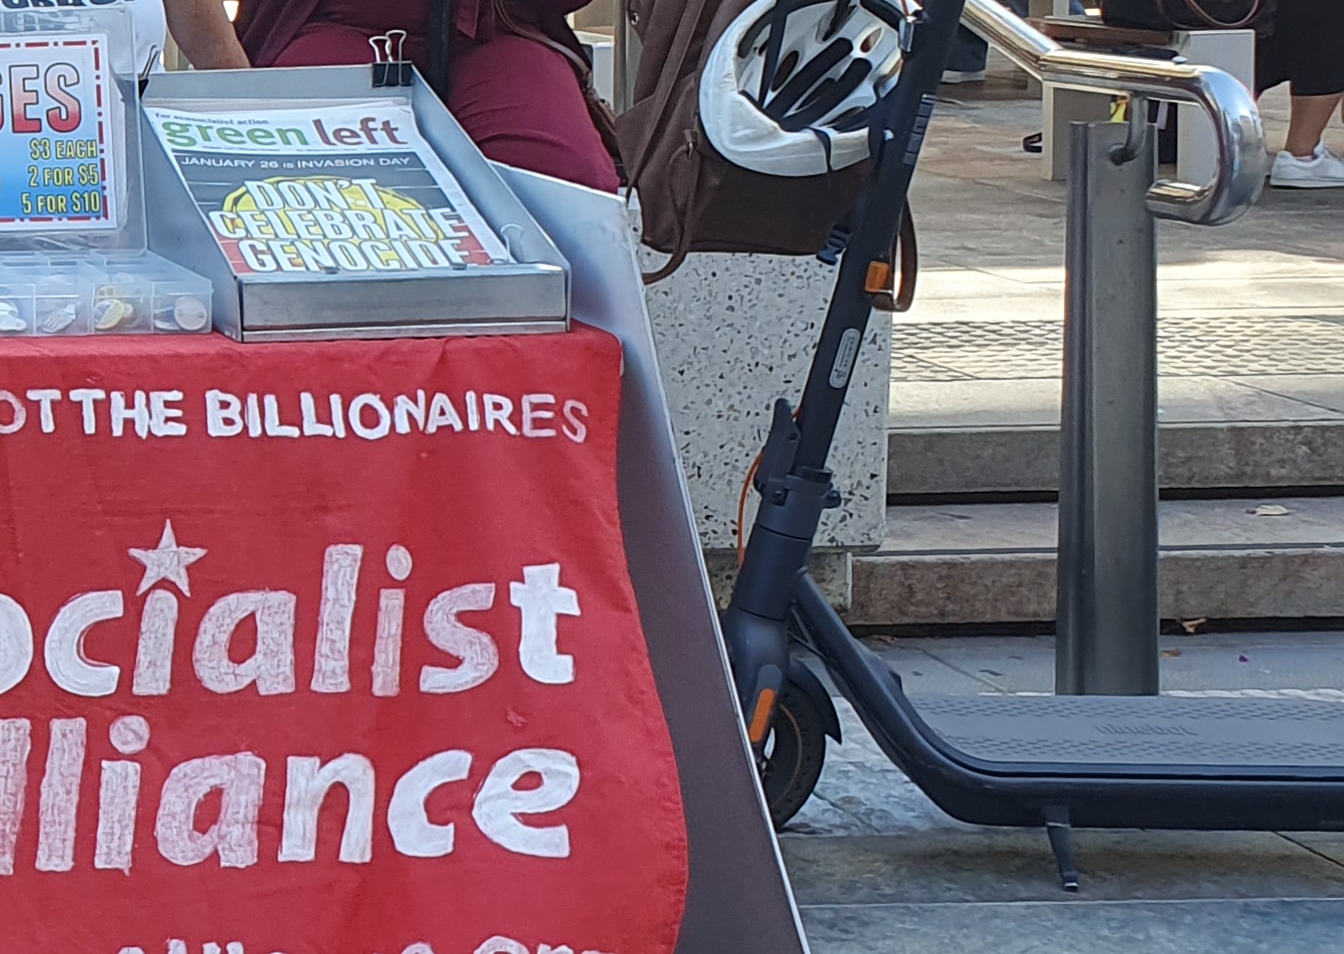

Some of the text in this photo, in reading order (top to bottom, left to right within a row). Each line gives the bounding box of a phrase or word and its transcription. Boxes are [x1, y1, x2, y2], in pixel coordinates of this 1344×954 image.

[161, 116, 408, 147] green left
[29, 139, 98, 160] $3 EACH
[180, 156, 256, 169] JANUARY
[260, 160, 280, 169] 26
[297, 157, 377, 169] INVASION
[378, 156, 411, 167] DAY
[28, 164, 99, 187] 2 FOR $5
[21, 191, 101, 214] 5 FOR $10
[243, 178, 388, 210] DON'T
[208, 208, 470, 239] CELEBRATE
[238, 238, 470, 272] GENOCIDE
[69, 388, 184, 437] THE
[205, 388, 589, 443] BILLIONAIRES
